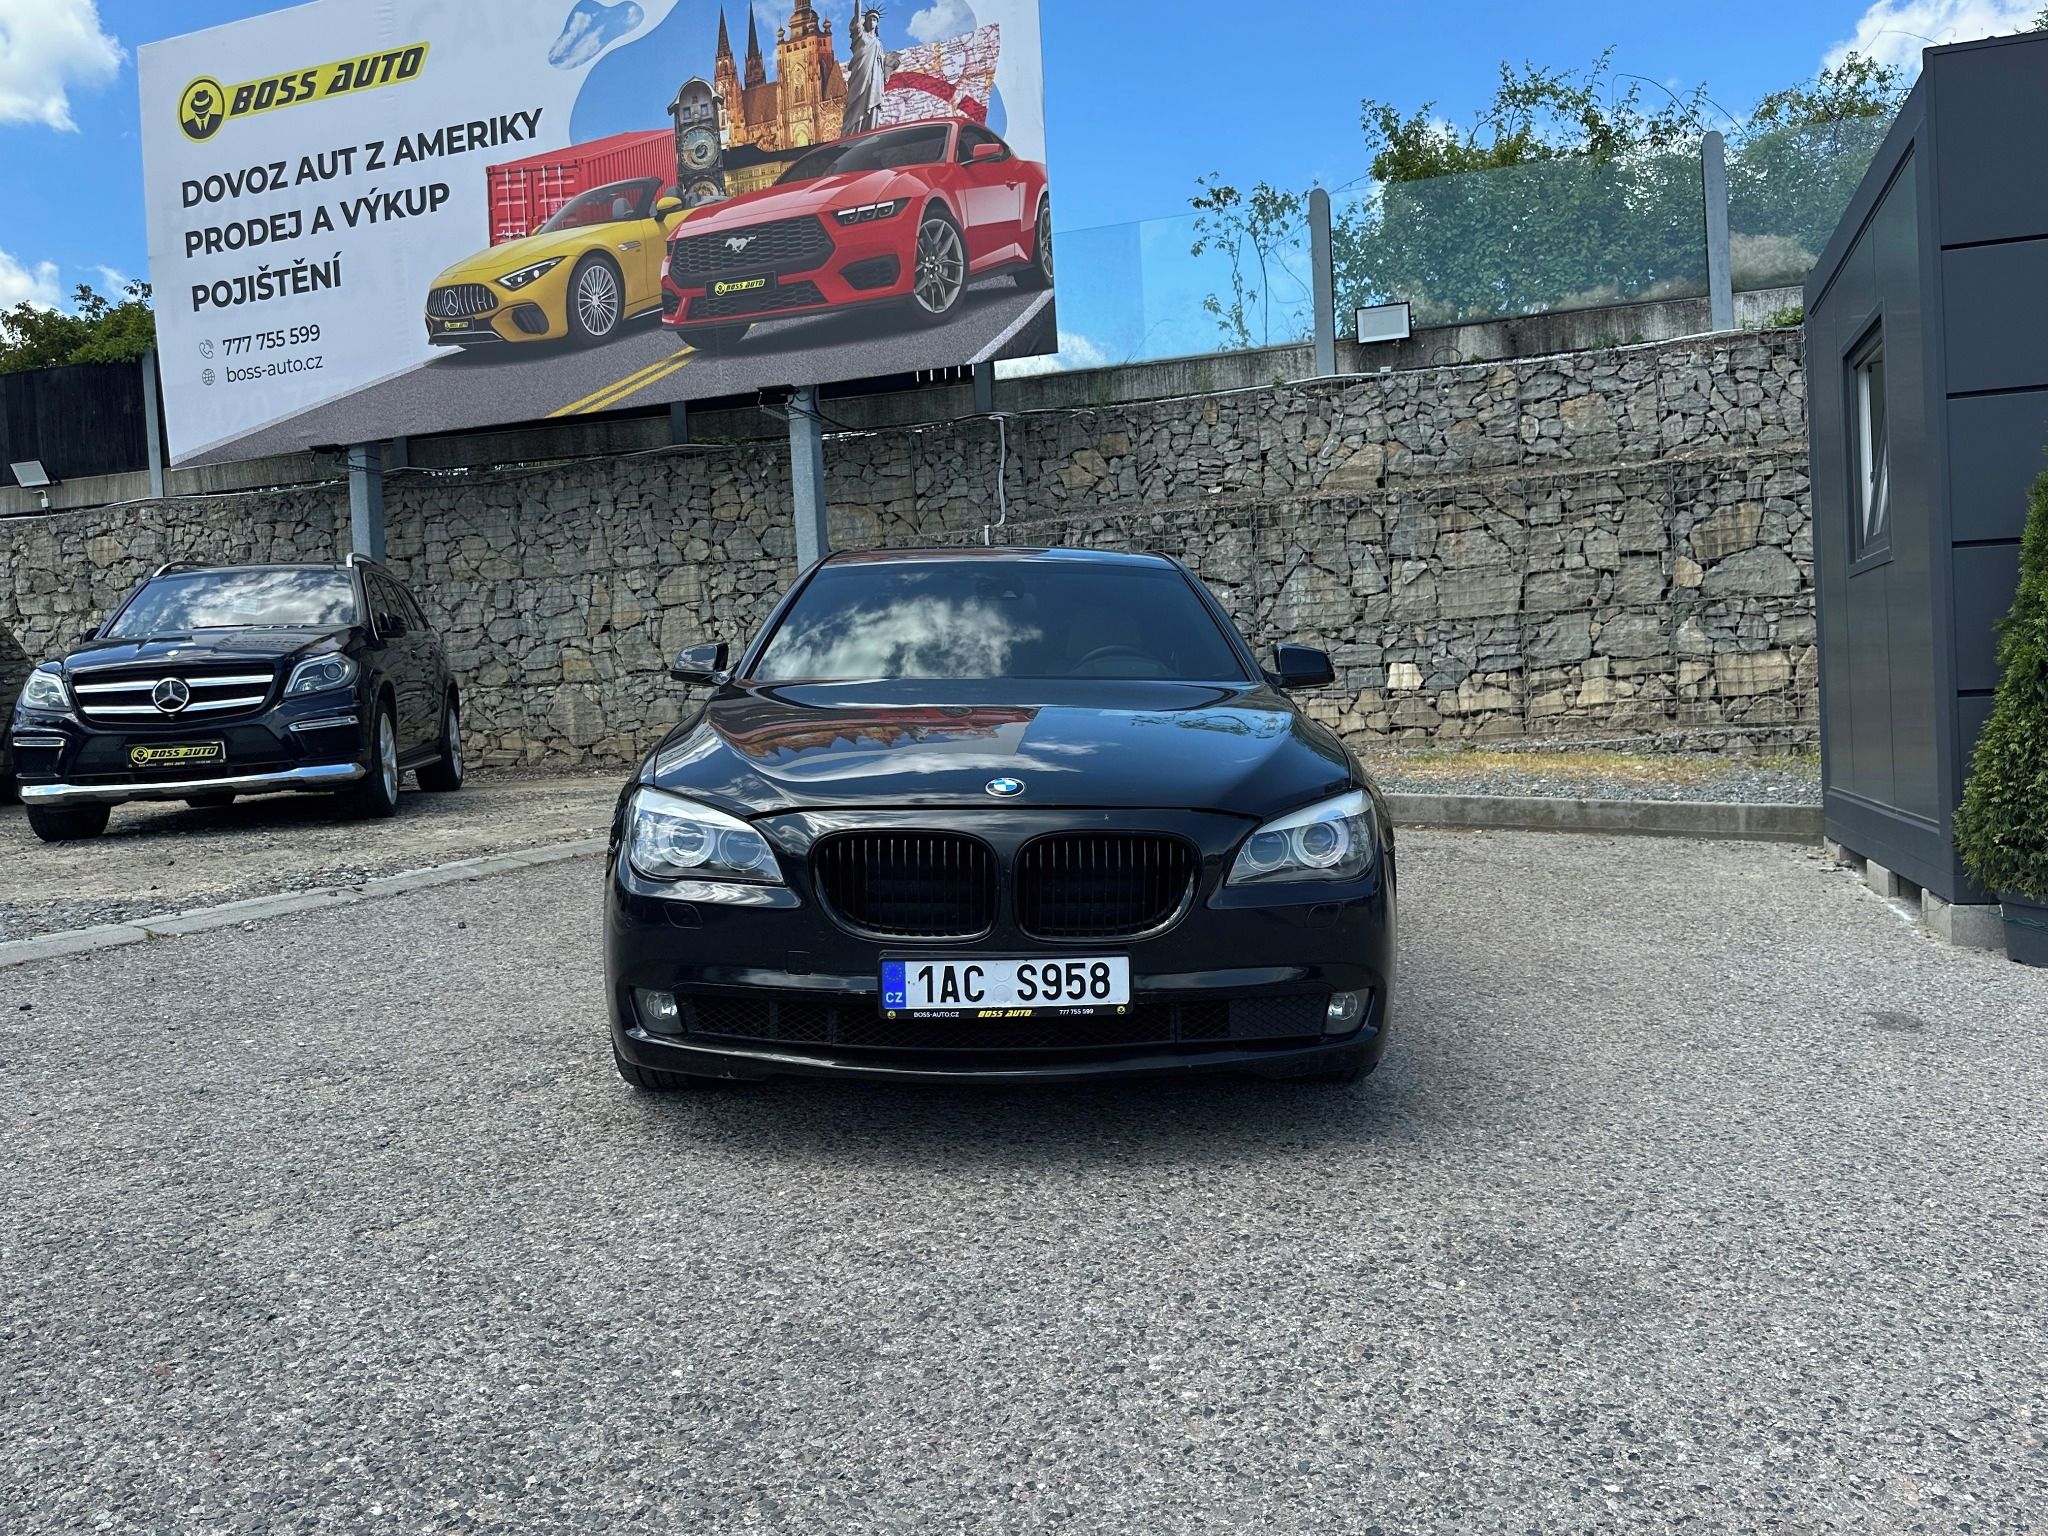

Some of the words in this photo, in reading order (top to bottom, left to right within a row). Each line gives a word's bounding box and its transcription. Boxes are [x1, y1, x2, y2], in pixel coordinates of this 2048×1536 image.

[230, 70, 318, 115] BOSS
[325, 46, 425, 95] AUTO
[181, 161, 288, 208] DOVOZ
[295, 147, 357, 185] AUT
[365, 140, 386, 171] Z
[393, 108, 543, 166] AMERIKY
[185, 210, 302, 258] PRODEJ
[311, 205, 334, 235] A
[339, 182, 450, 228] VÝKUP
[192, 251, 343, 312] POJIŠTĚNÍ
[222, 335, 252, 356] 777
[256, 330, 286, 350] 755
[289, 324, 321, 345] 599
[226, 355, 324, 383] boss-auto.cz
[150, 749, 180, 758] BOSS
[183, 747, 217, 756] AUTO
[885, 991, 903, 1004] CZ
[918, 965, 985, 1003] 1AC
[1016, 962, 1111, 1001] S958
[977, 1010, 1003, 1018] BOSS
[1005, 1009, 1032, 1017] AUTO
